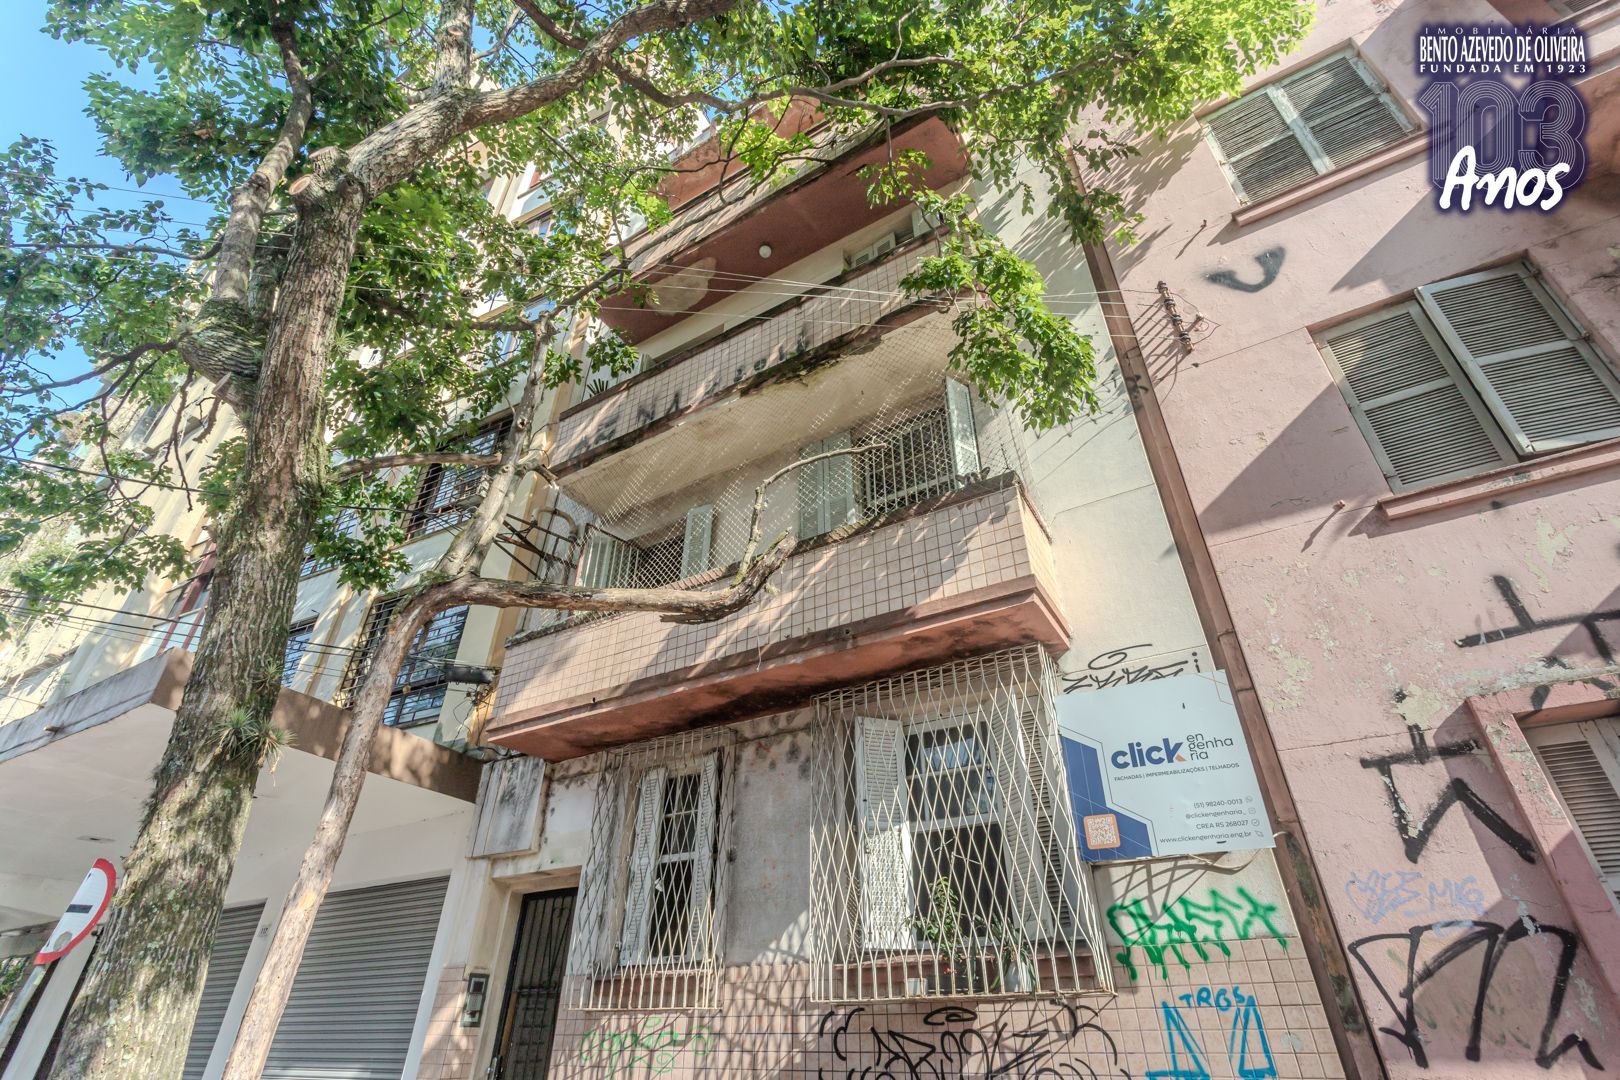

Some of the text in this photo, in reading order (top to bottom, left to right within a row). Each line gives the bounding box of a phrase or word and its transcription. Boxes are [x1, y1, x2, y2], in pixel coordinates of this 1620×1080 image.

[1186, 733, 1205, 743] en
[1188, 736, 1234, 752] genha
[1110, 737, 1185, 770] click
[1189, 750, 1209, 761] ria
[1113, 762, 1240, 782] FACHADAS IMPERMEABILIZAÇÕES TELHADOS
[1195, 822, 1215, 830] CREA
